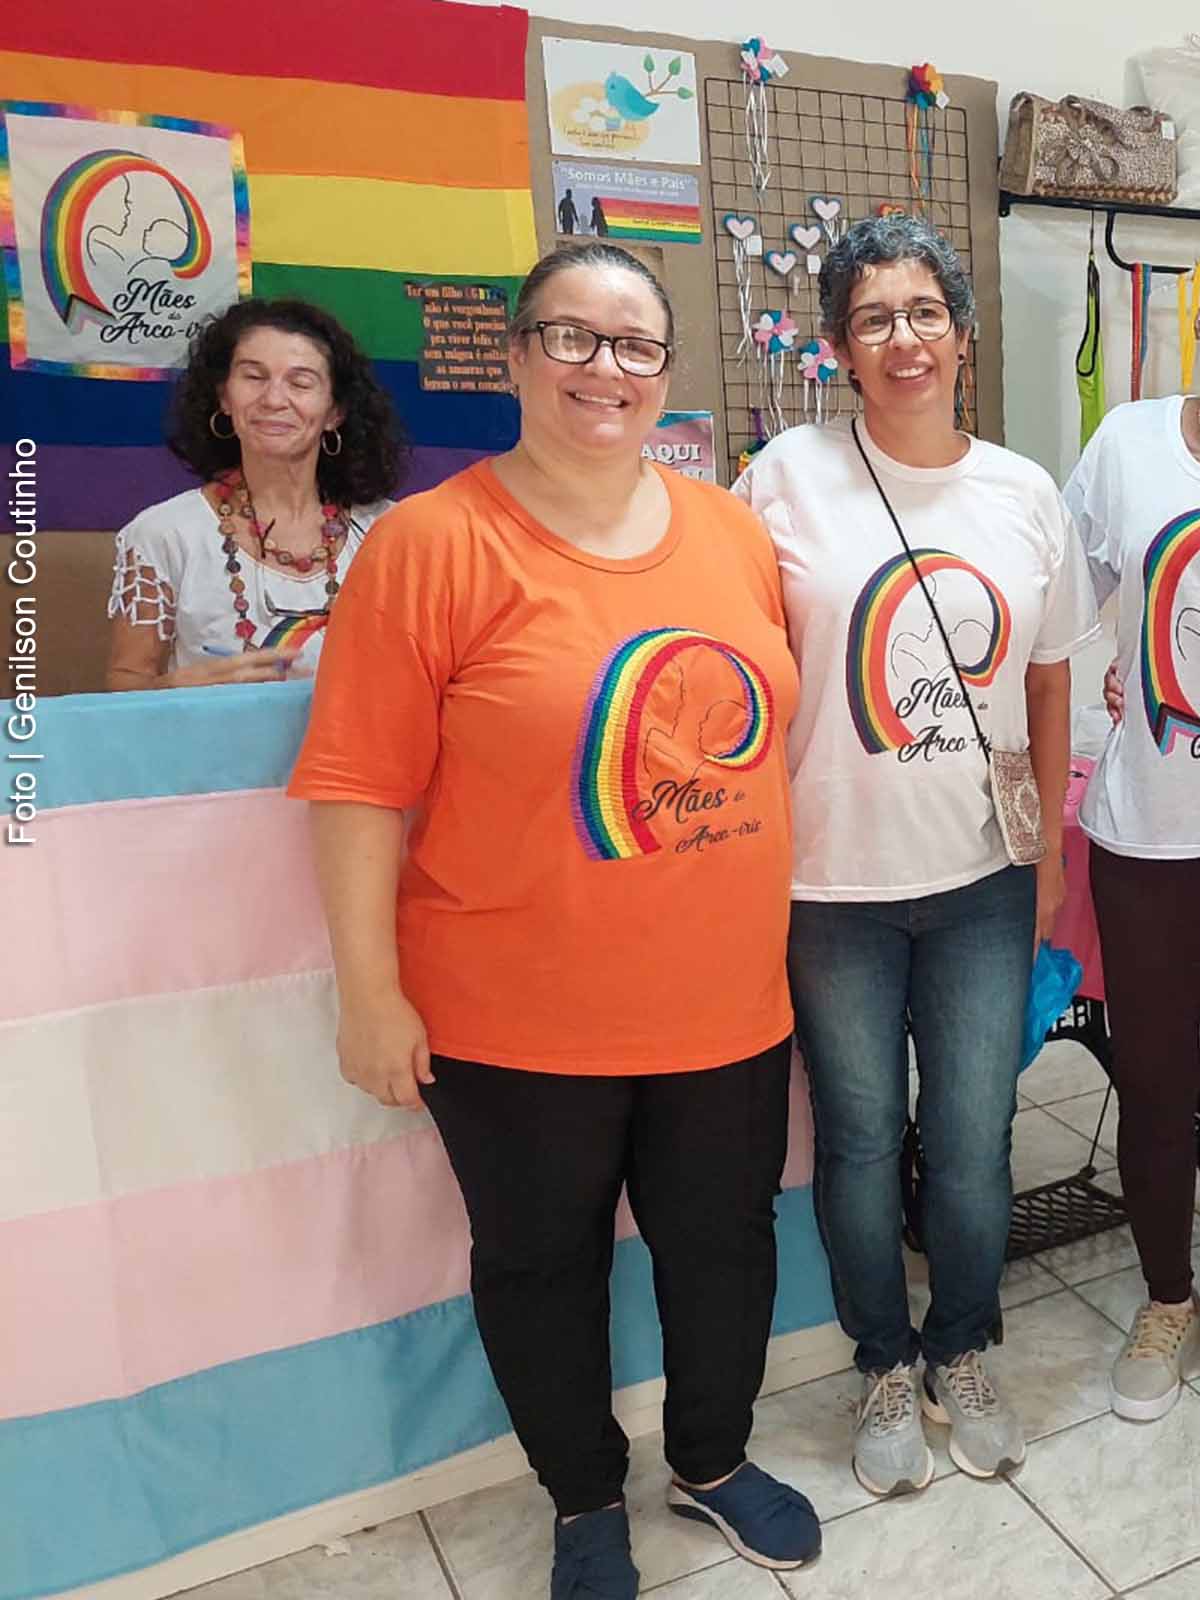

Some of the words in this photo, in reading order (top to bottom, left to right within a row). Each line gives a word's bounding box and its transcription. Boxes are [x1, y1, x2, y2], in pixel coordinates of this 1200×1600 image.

[112, 278, 196, 315] Mães
[640, 443, 702, 465] AQUI
[631, 778, 729, 824] Mães
